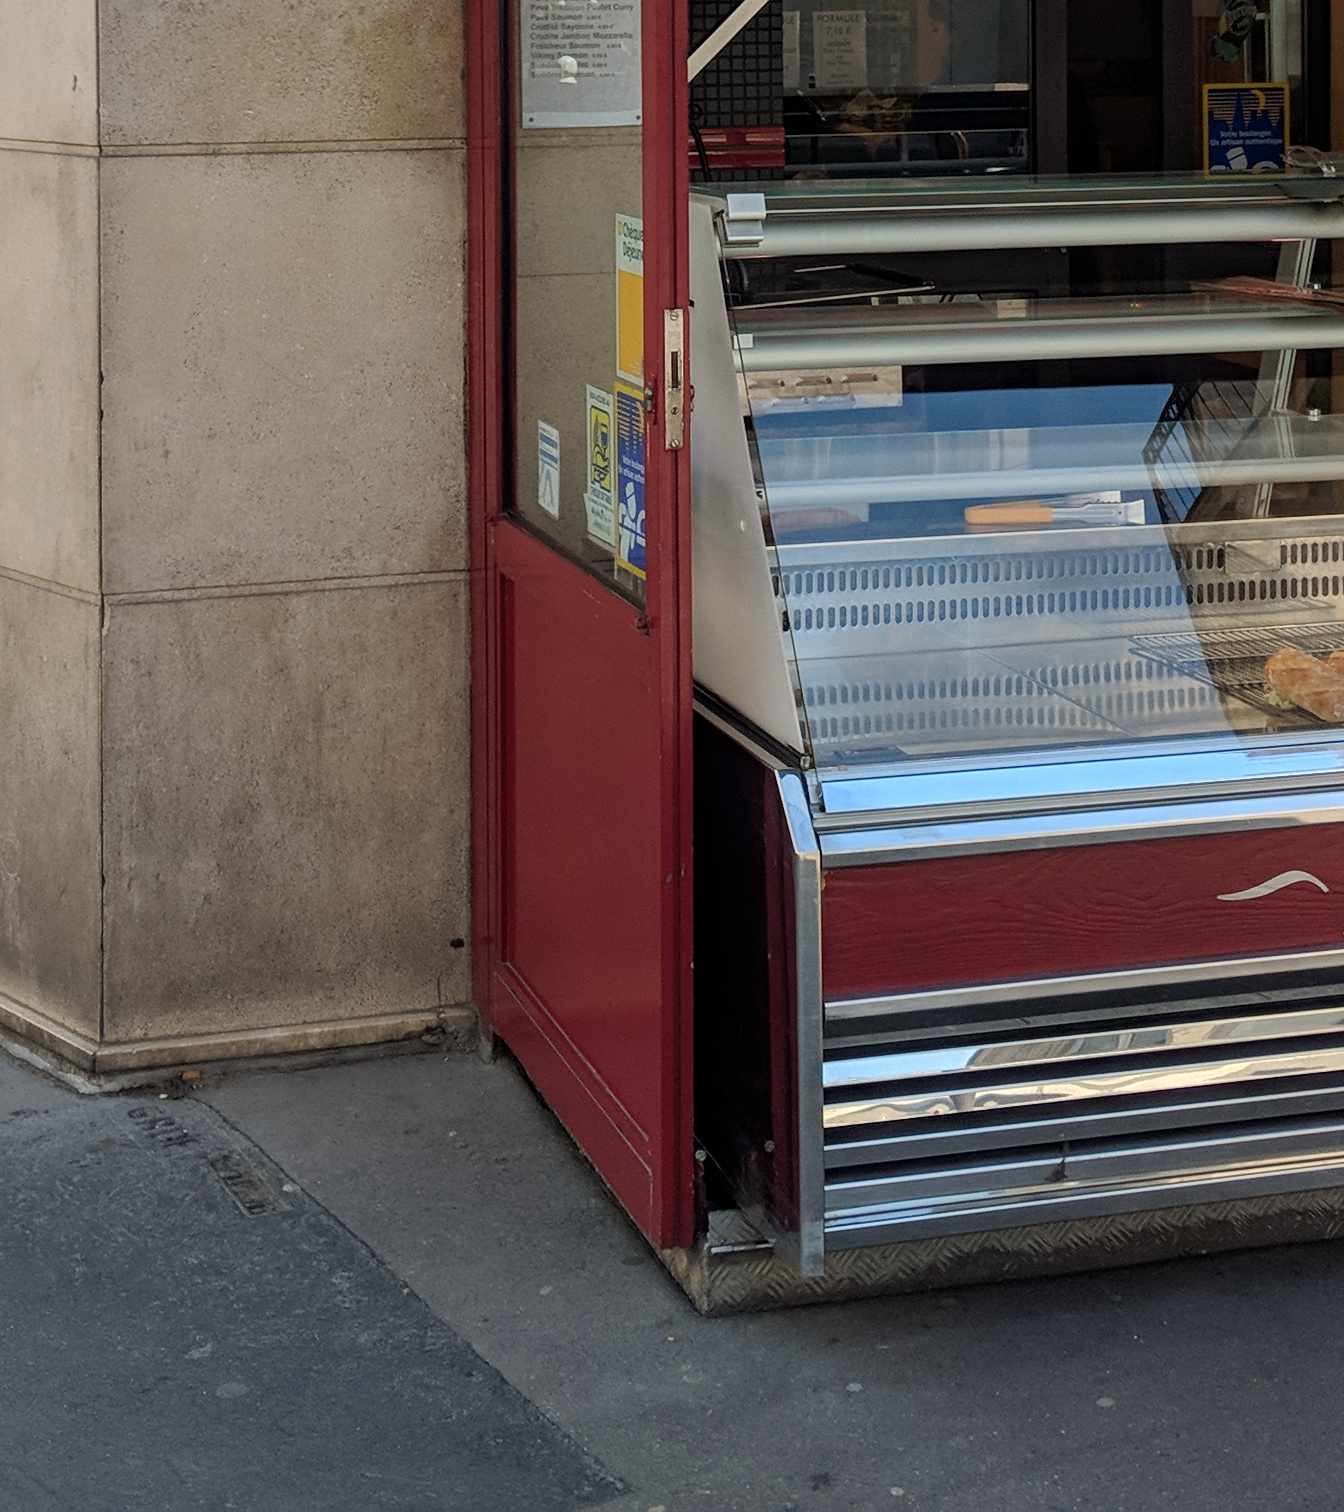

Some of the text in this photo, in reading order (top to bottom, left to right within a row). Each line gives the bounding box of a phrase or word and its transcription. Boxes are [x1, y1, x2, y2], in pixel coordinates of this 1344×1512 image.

[816, 14, 861, 24] FORMULE
[1220, 130, 1239, 138] Votre
[1221, 138, 1244, 146] artisan
[1245, 137, 1283, 147] authentique
